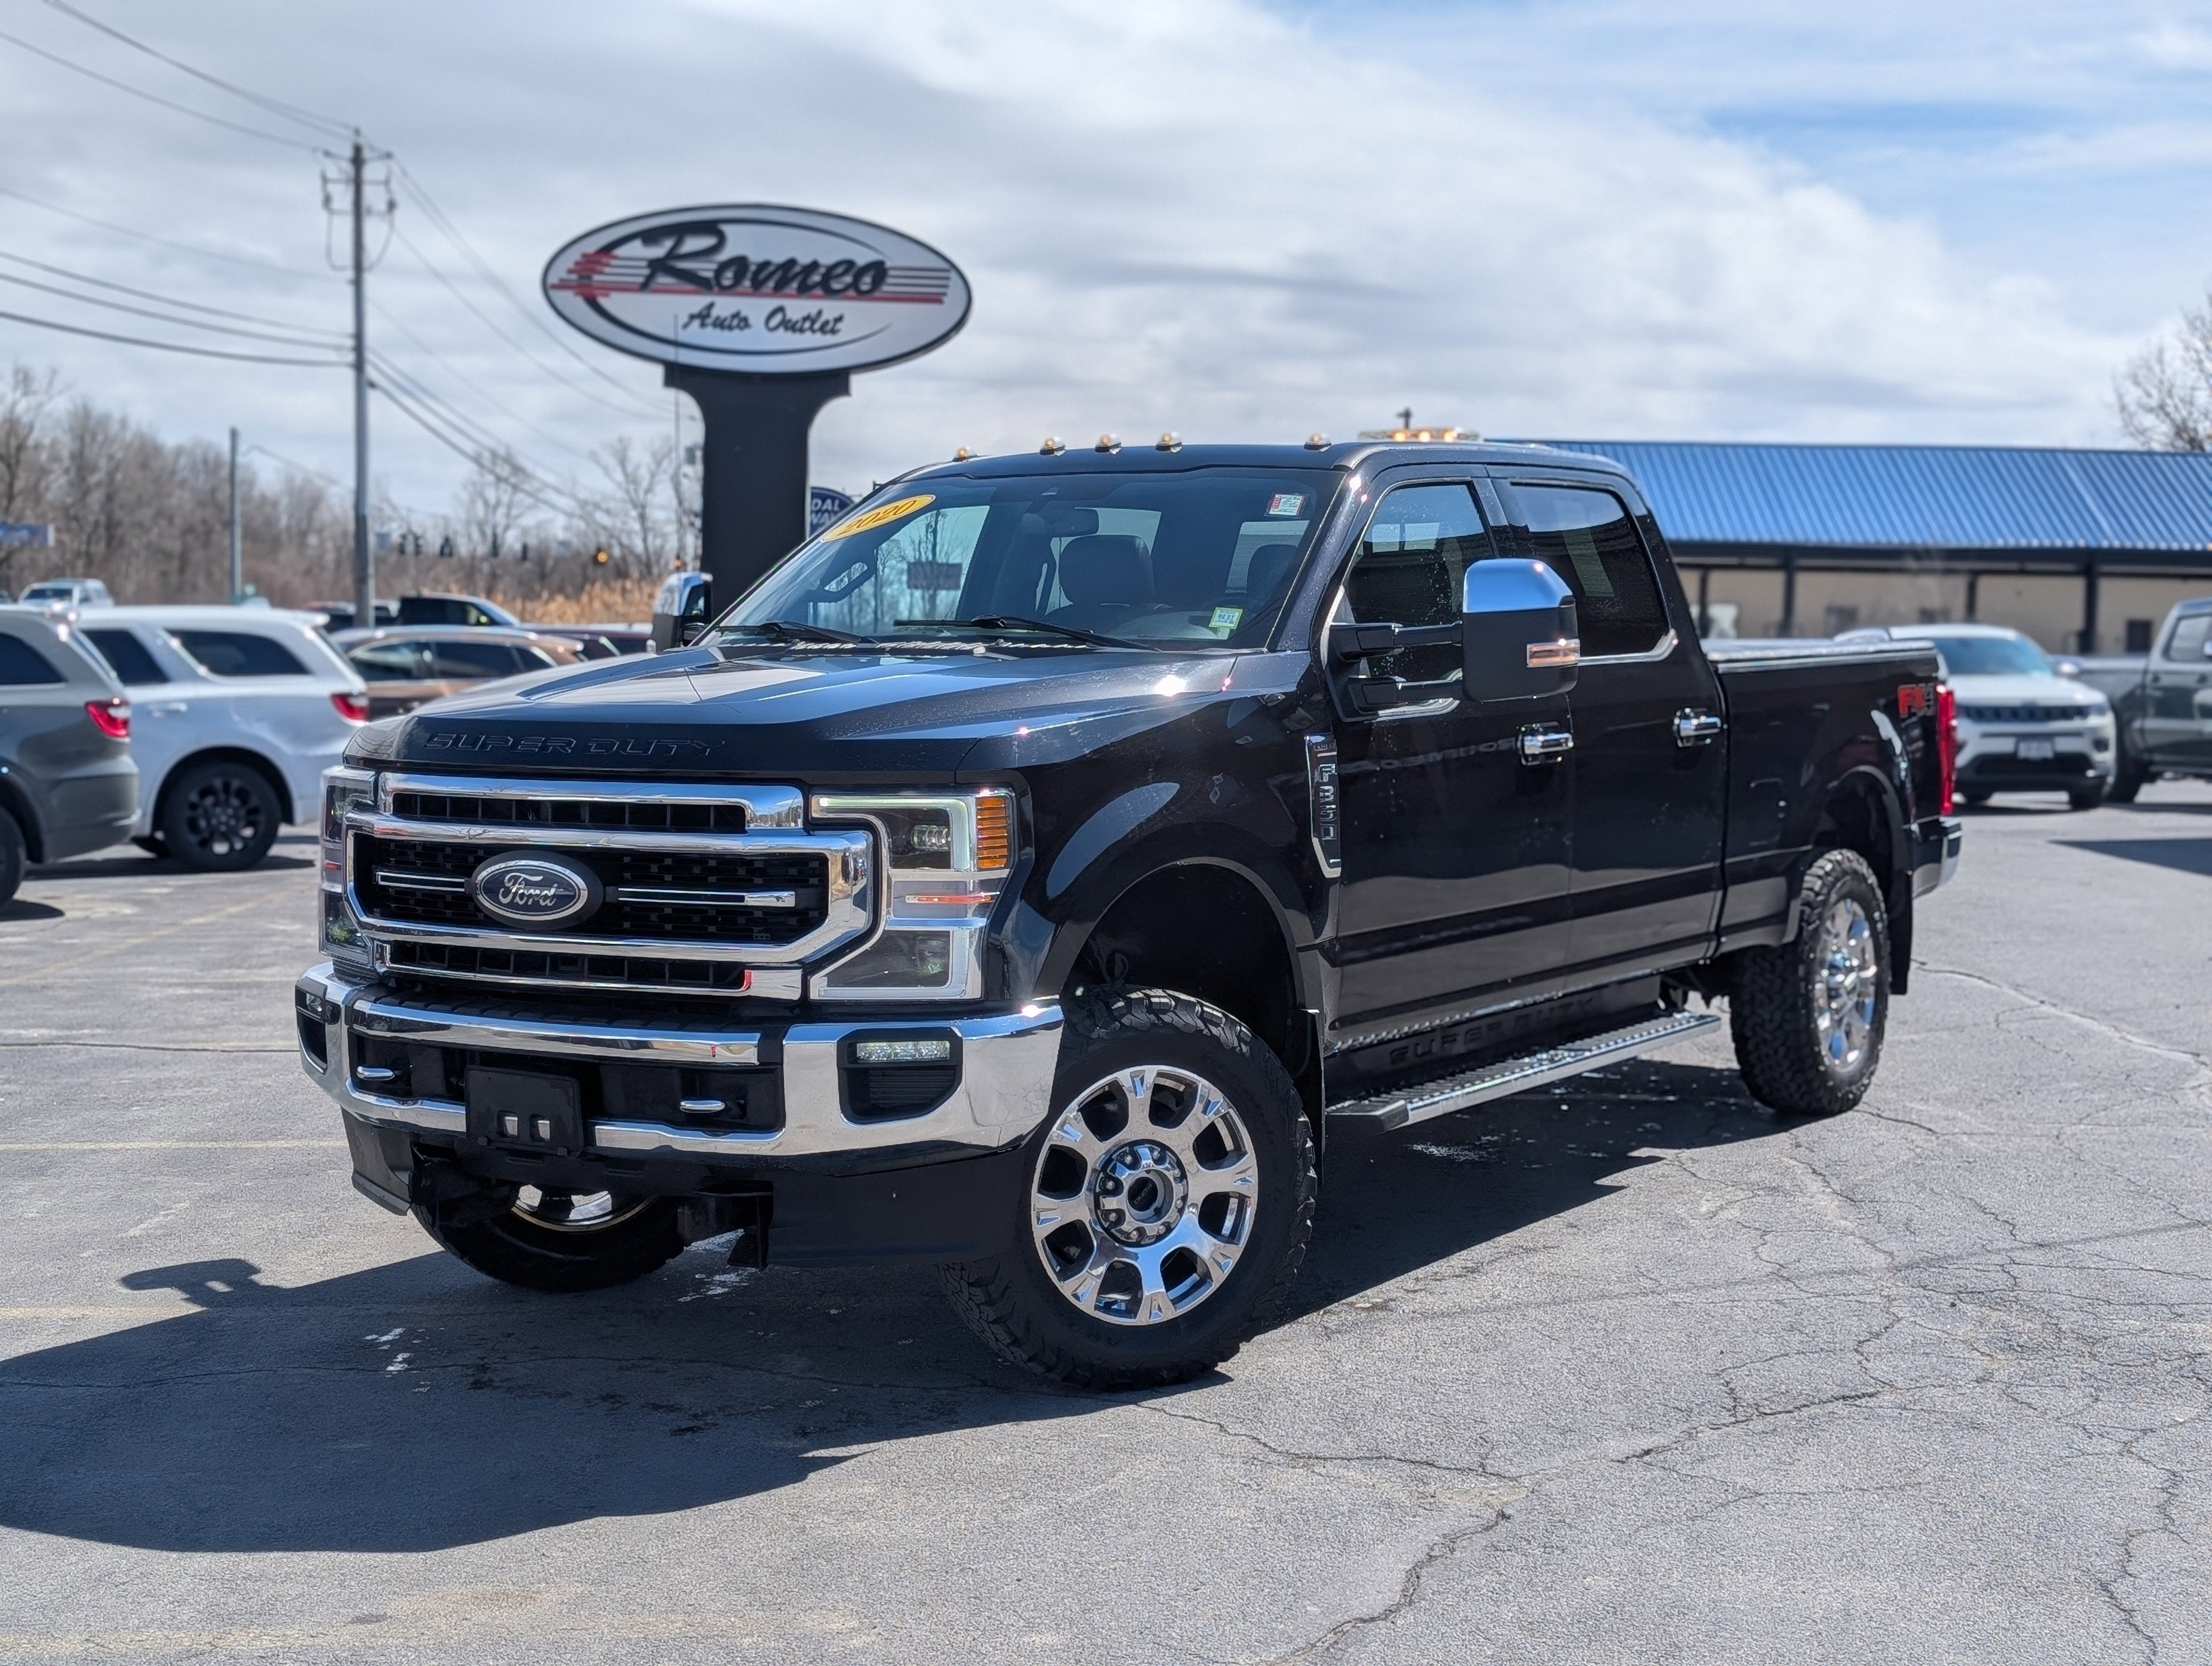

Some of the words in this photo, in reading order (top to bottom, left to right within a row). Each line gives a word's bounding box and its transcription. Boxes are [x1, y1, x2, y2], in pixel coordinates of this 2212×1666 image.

[640, 220, 888, 296] Romeo
[681, 301, 752, 332] Auto
[764, 305, 845, 335] Outlet
[835, 499, 917, 537] 2020
[422, 733, 577, 753] SUPER
[587, 738, 726, 757] DUTY
[498, 872, 558, 906] Ford
